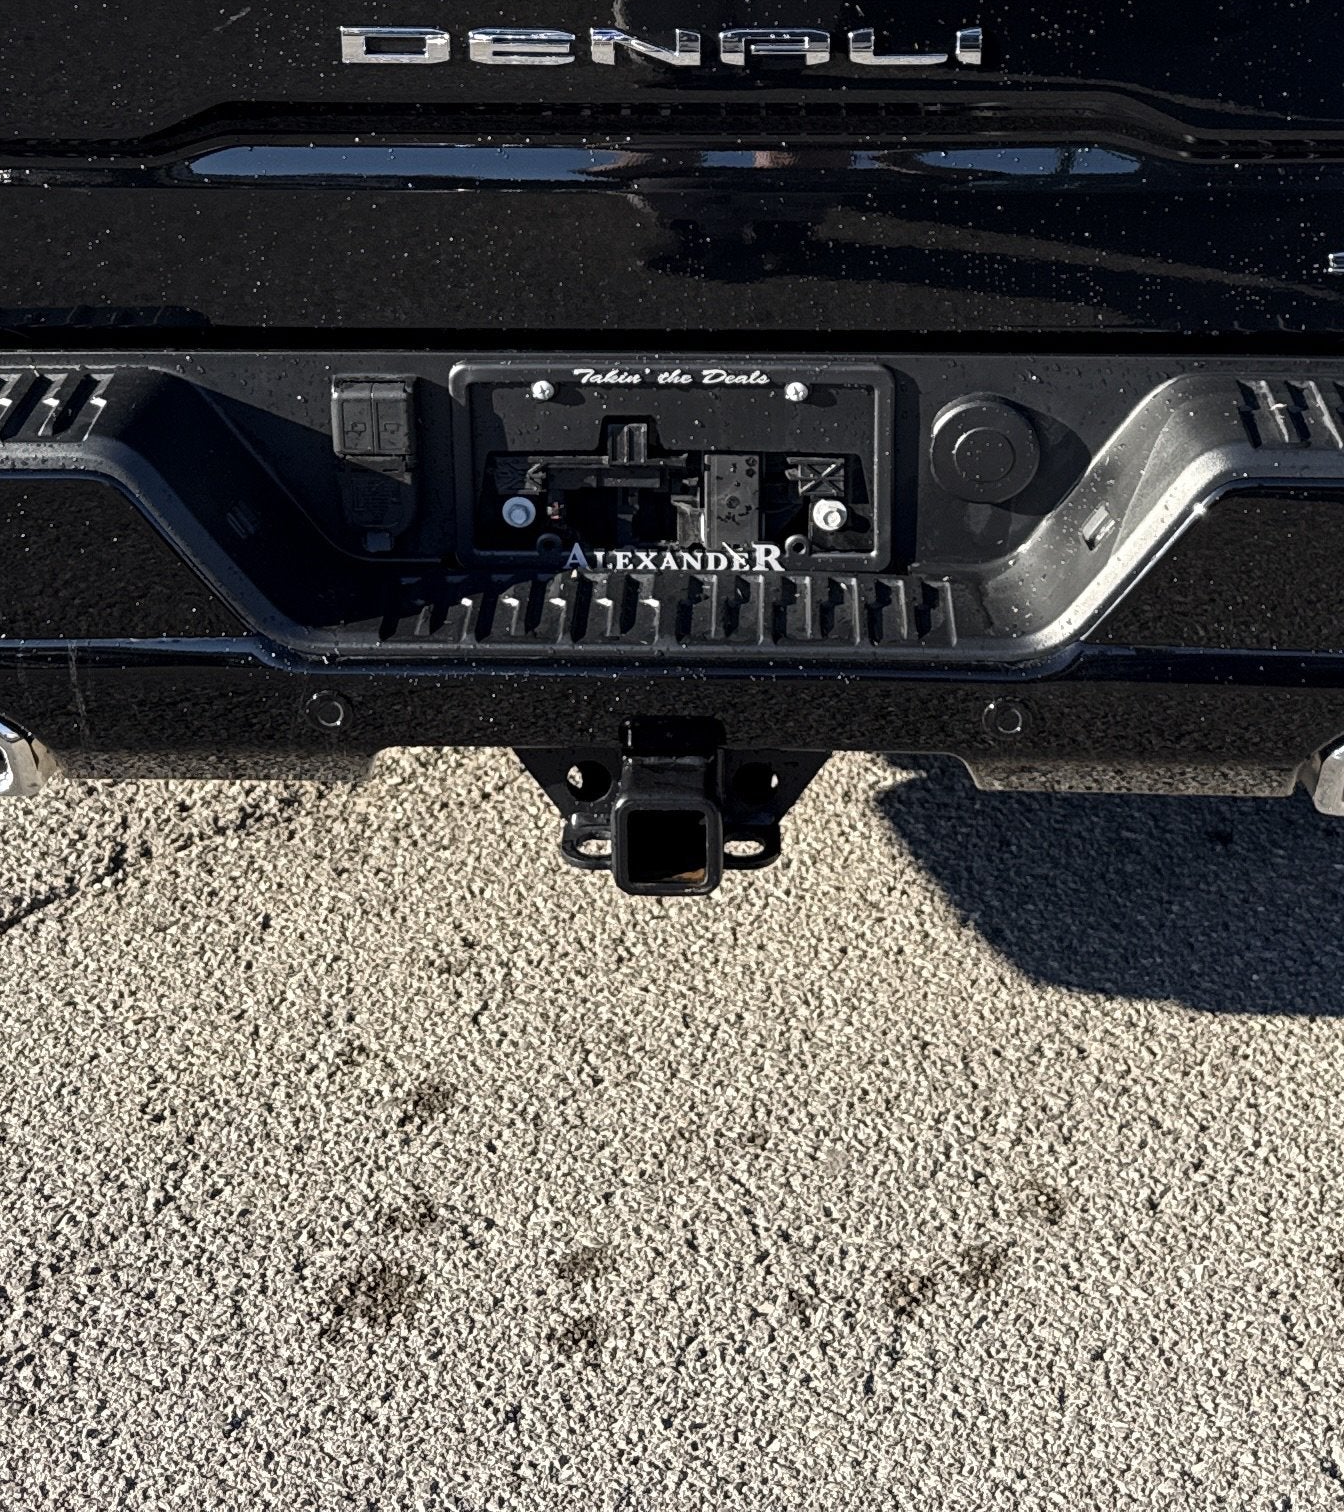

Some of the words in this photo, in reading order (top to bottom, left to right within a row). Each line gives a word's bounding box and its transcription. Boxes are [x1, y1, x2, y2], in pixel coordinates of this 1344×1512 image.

[340, 27, 983, 66] DENALI
[573, 368, 651, 384] Takin'
[657, 369, 693, 384] the
[702, 369, 770, 384] Deals
[563, 542, 785, 571] ALEXANDER
